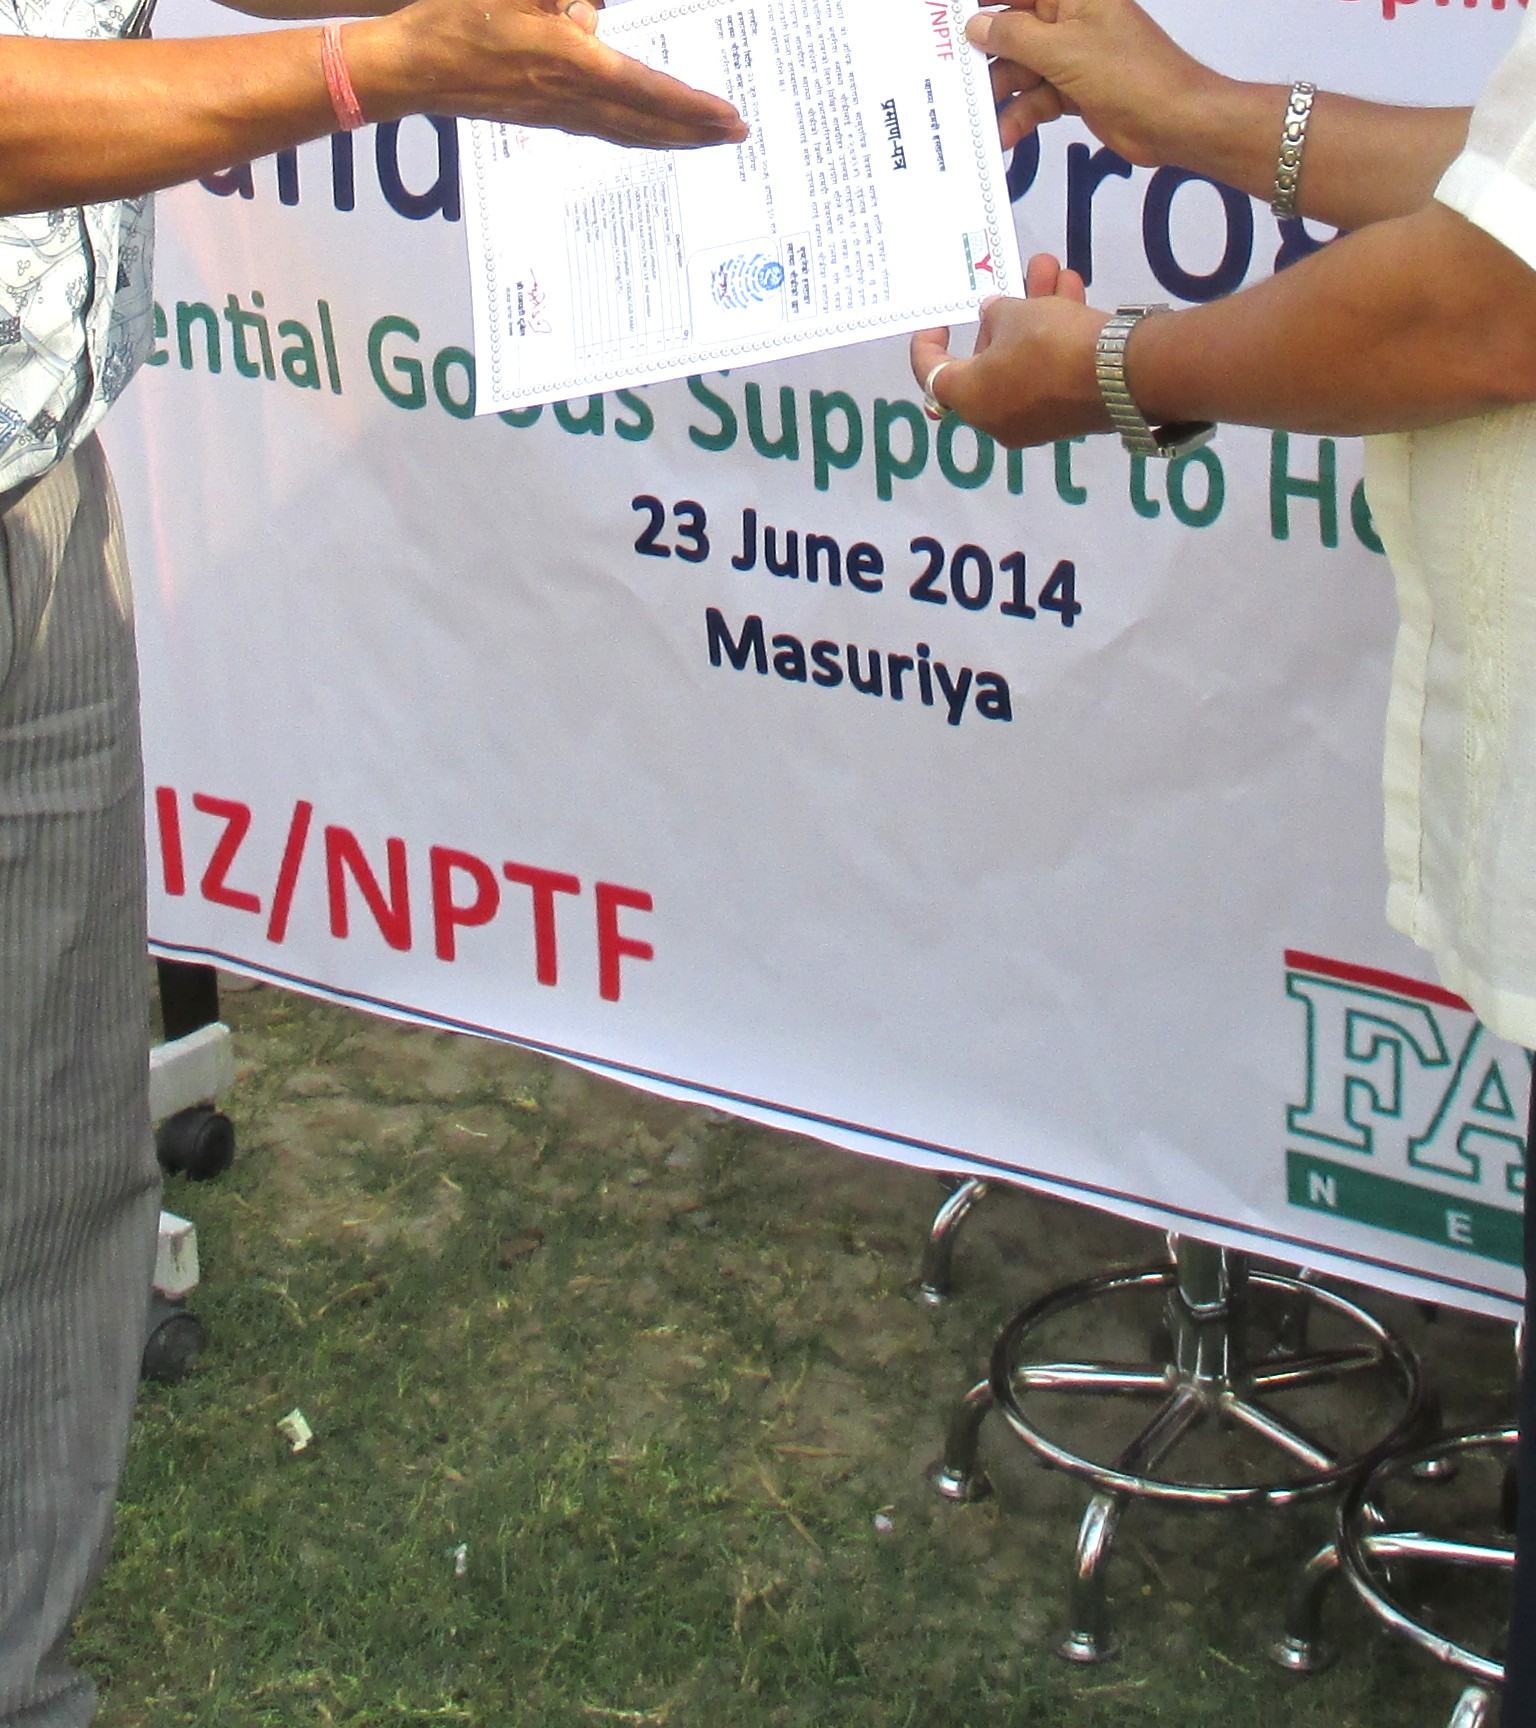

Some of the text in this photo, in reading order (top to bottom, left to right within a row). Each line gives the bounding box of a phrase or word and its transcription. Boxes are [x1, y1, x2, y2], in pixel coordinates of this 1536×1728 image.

[880, 98, 907, 170] प्रमाण-पत्र
[631, 495, 1083, 629] 23 June 2014
[704, 607, 1014, 726] Masuriya
